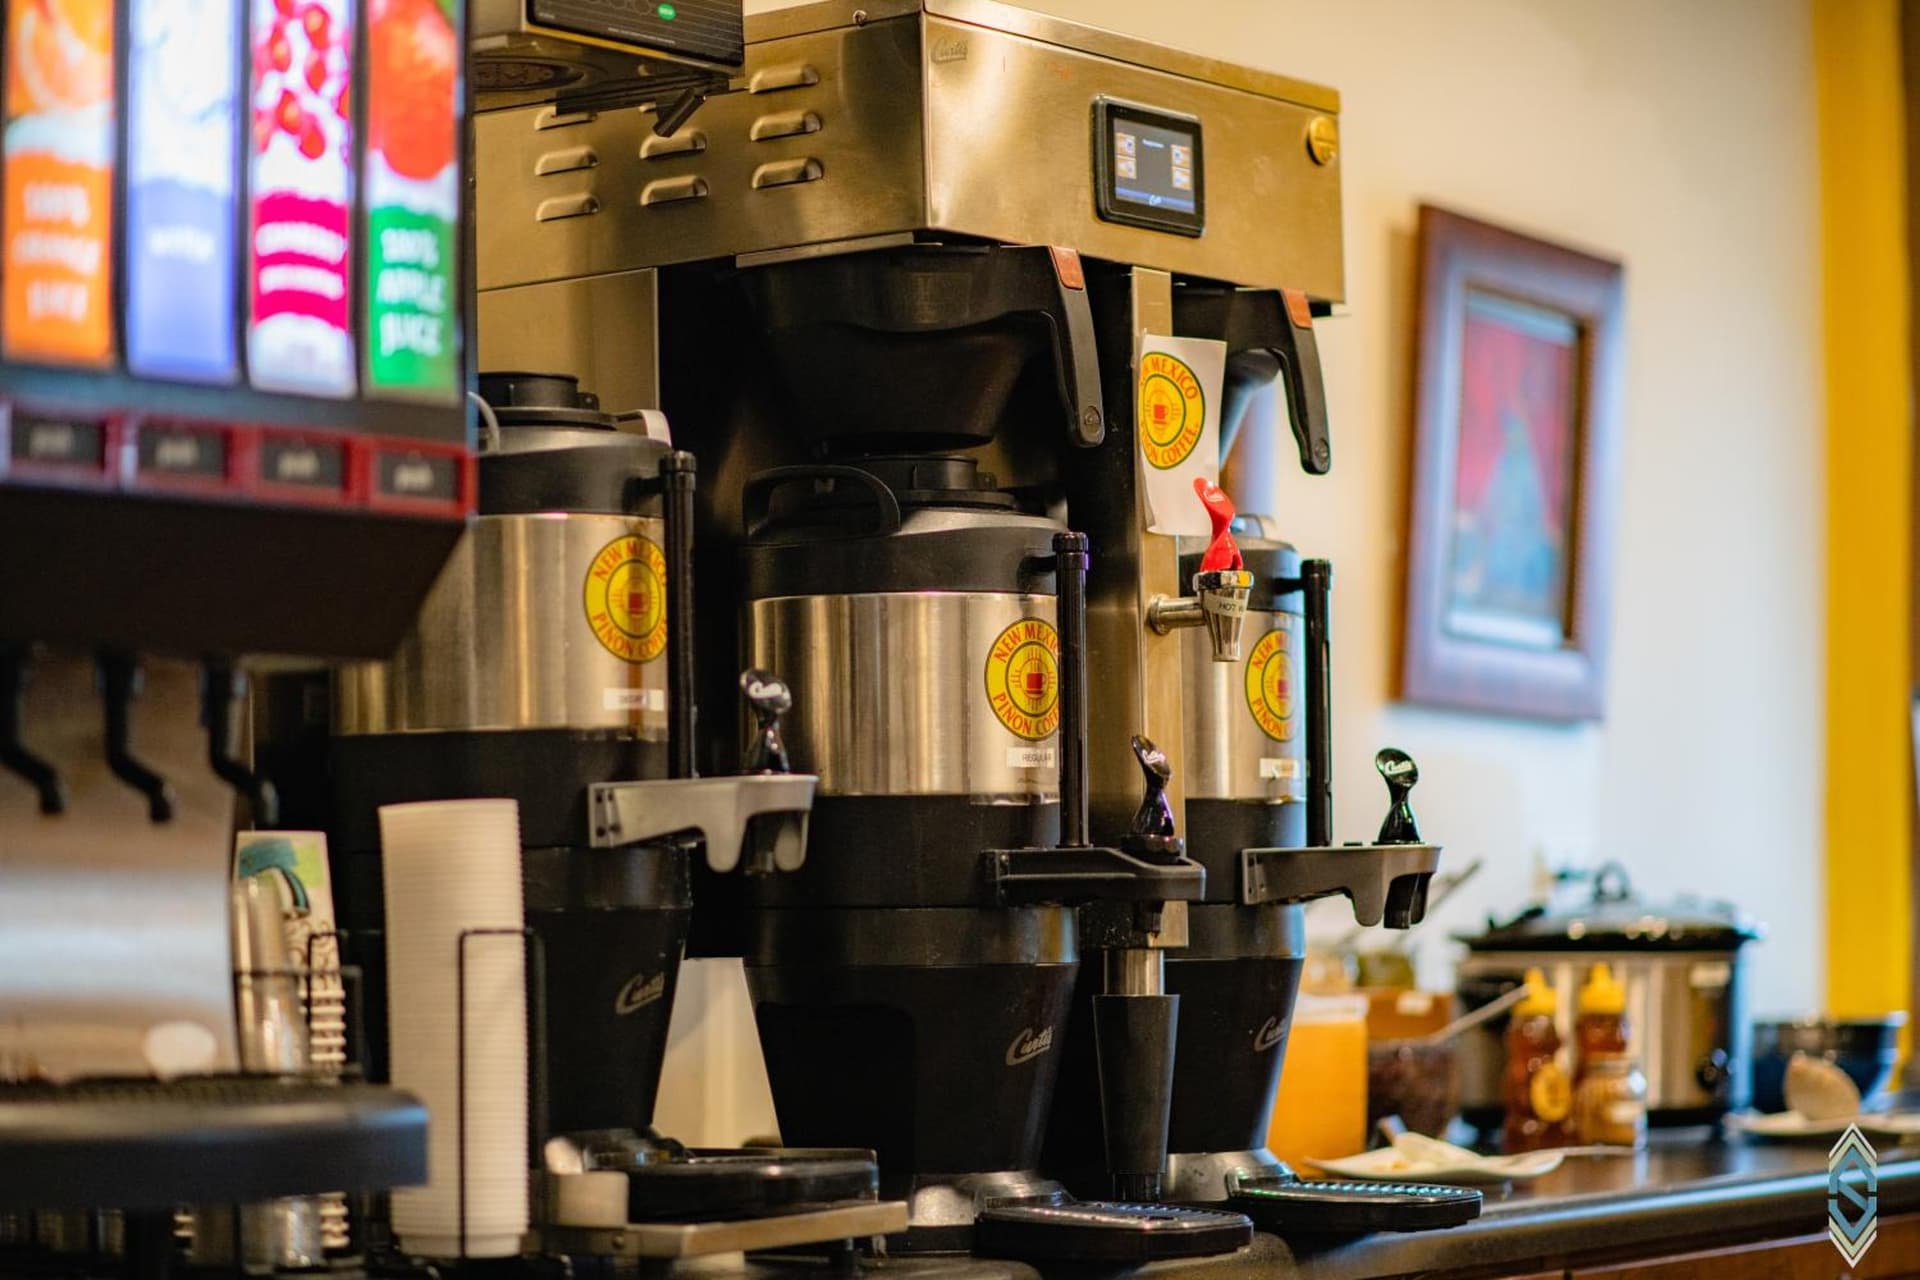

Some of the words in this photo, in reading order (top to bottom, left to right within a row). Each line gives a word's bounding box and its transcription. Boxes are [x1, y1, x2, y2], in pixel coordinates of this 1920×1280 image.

[379, 312, 443, 357] JUICE
[1151, 357, 1198, 400] MEXICO
[593, 547, 622, 581] NEW
[1218, 601, 1236, 611] HOT
[593, 613, 633, 657] PINON
[994, 627, 1021, 663] NEW
[1252, 640, 1274, 669] NEW
[993, 692, 1032, 736] PINON
[1251, 697, 1282, 737] PINON
[1022, 752, 1052, 762] REGULAR
[1006, 1026, 1053, 1066] Curtis
